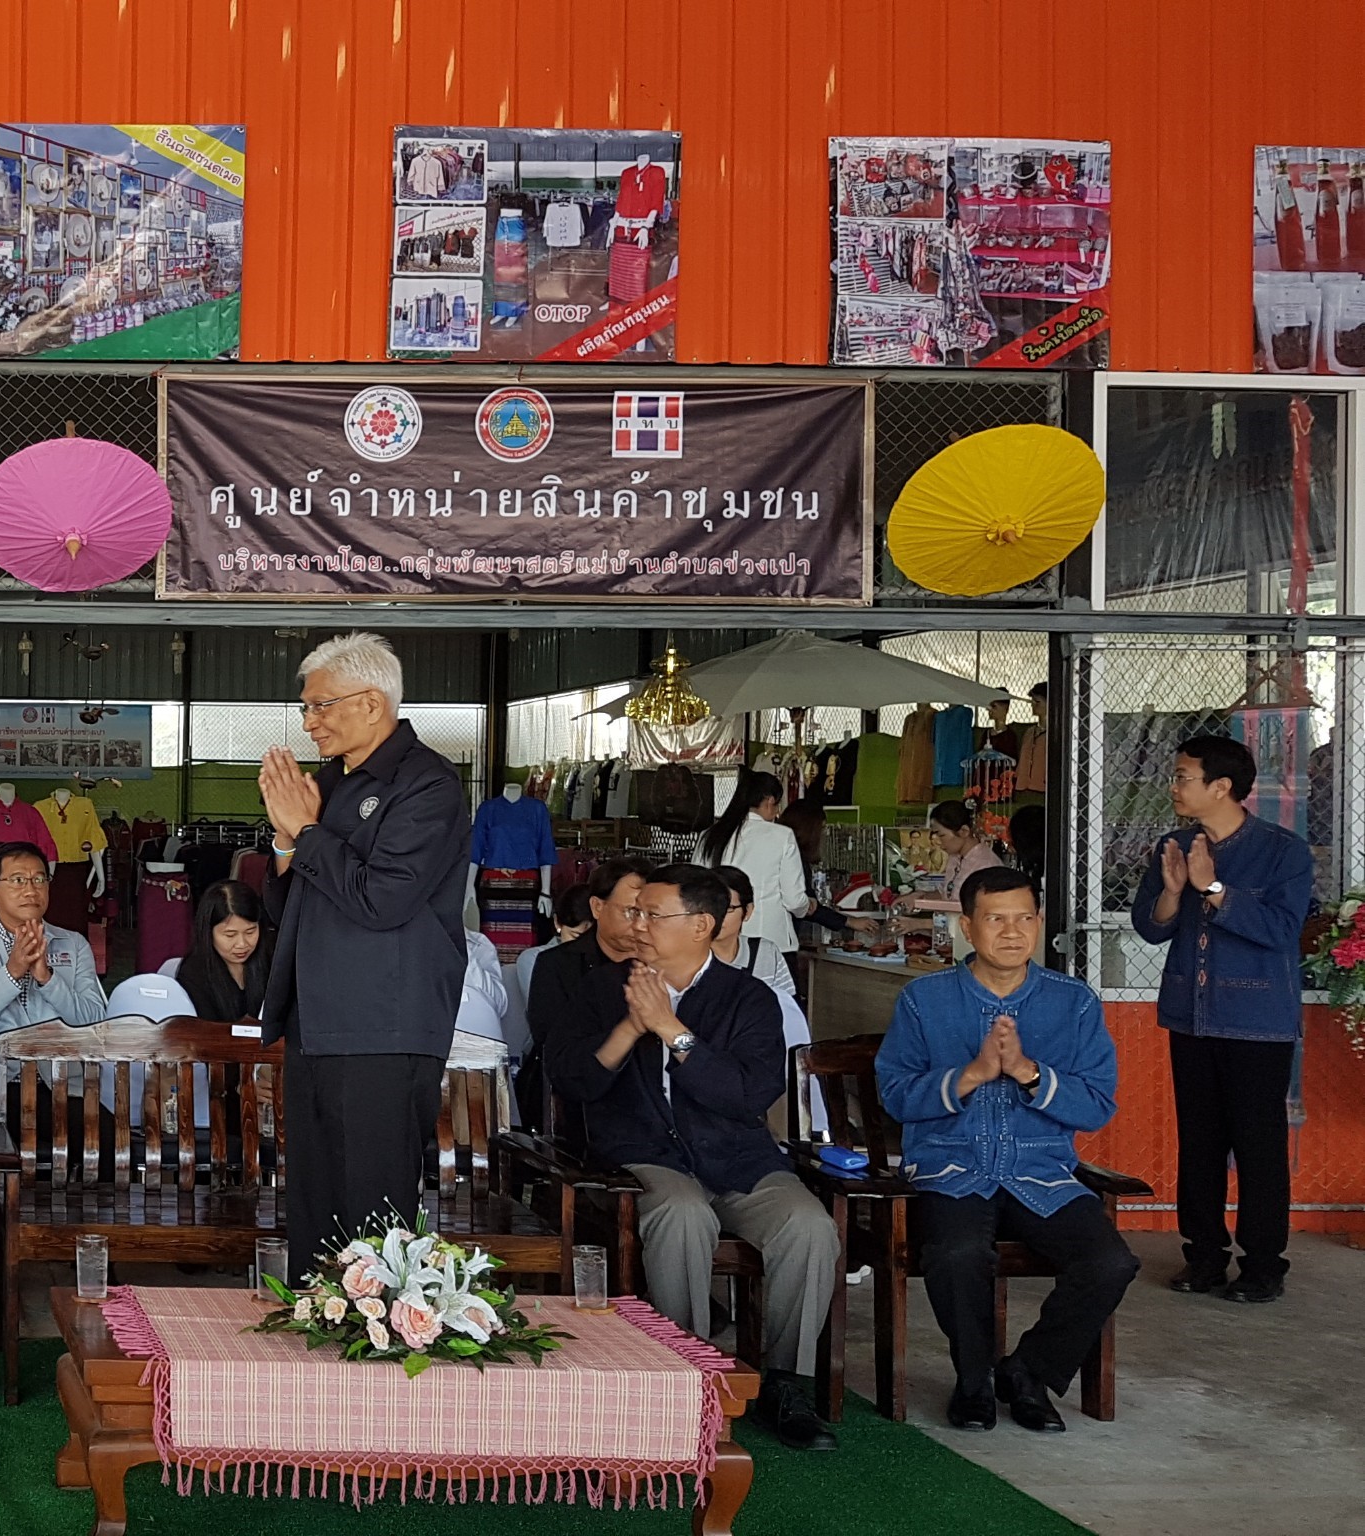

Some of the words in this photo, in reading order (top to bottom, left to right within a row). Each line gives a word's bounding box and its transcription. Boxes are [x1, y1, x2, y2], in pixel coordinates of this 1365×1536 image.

[155, 130, 242, 186] สินค้าแฮนด์เมด
[535, 304, 591, 323] OTOP
